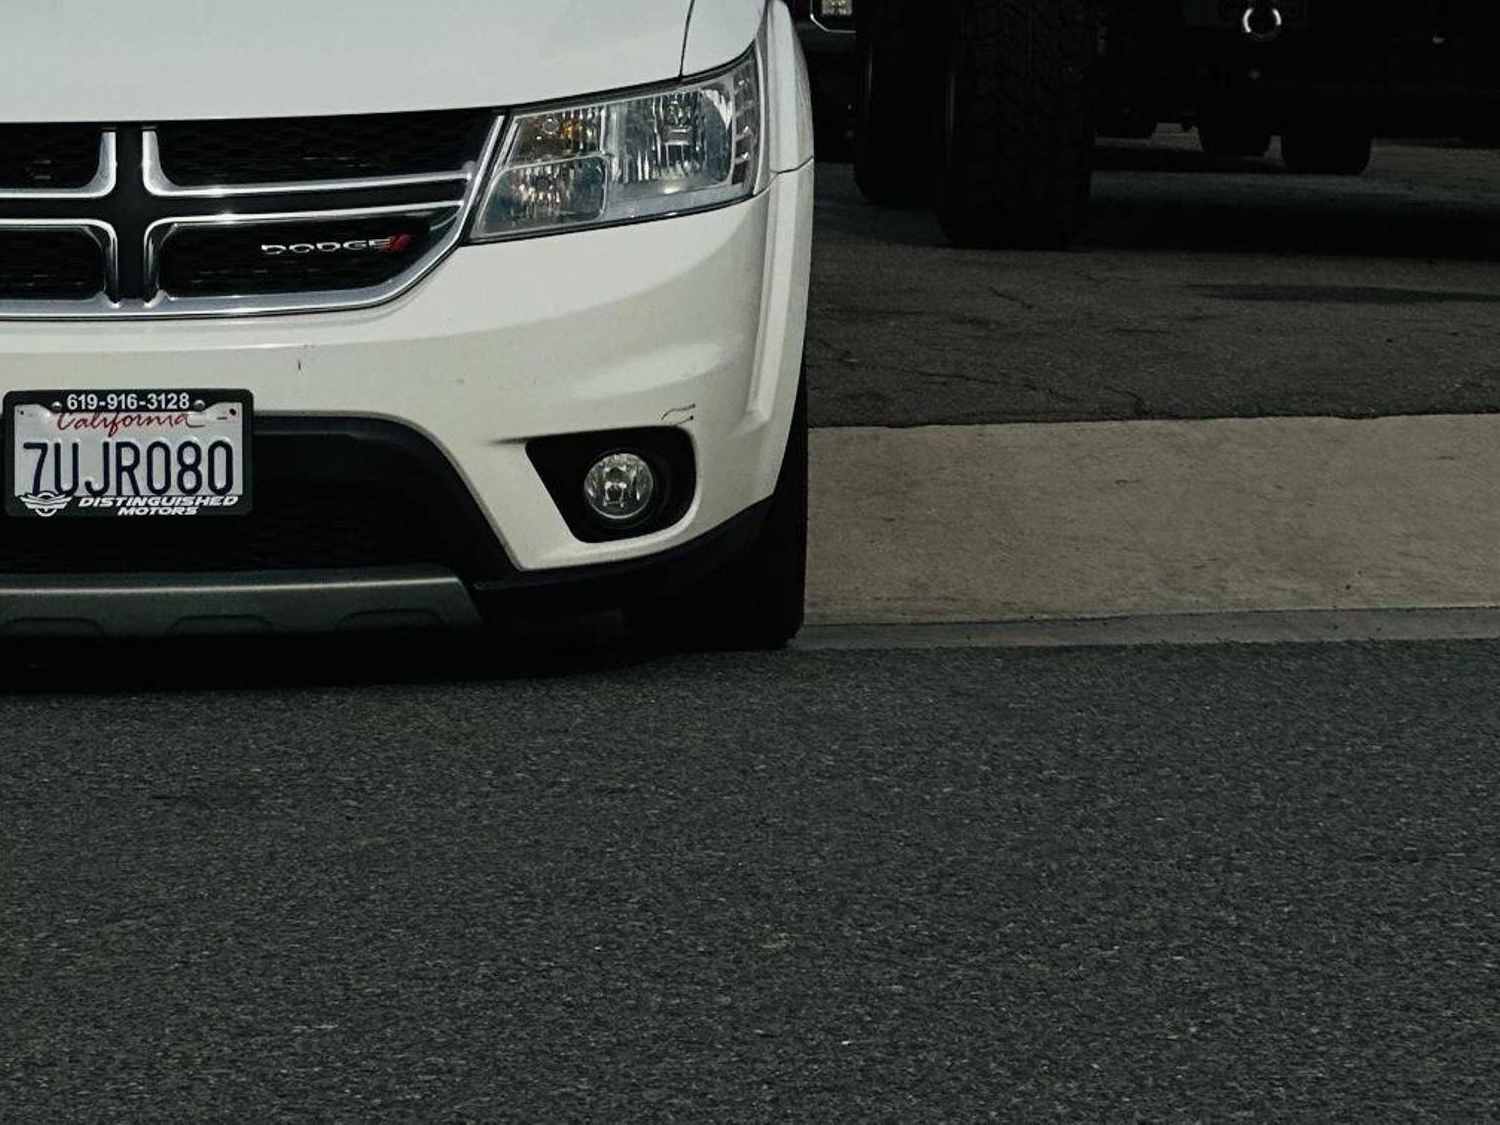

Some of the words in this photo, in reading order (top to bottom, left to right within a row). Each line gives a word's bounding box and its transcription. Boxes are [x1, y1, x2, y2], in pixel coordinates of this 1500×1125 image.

[261, 238, 389, 255] DODGE
[66, 392, 190, 410] 619-916-3128
[57, 411, 205, 437] California
[22, 440, 234, 496] 7UJR080
[78, 495, 239, 508] DISTINGUISHED
[117, 506, 199, 516] MOTORS
